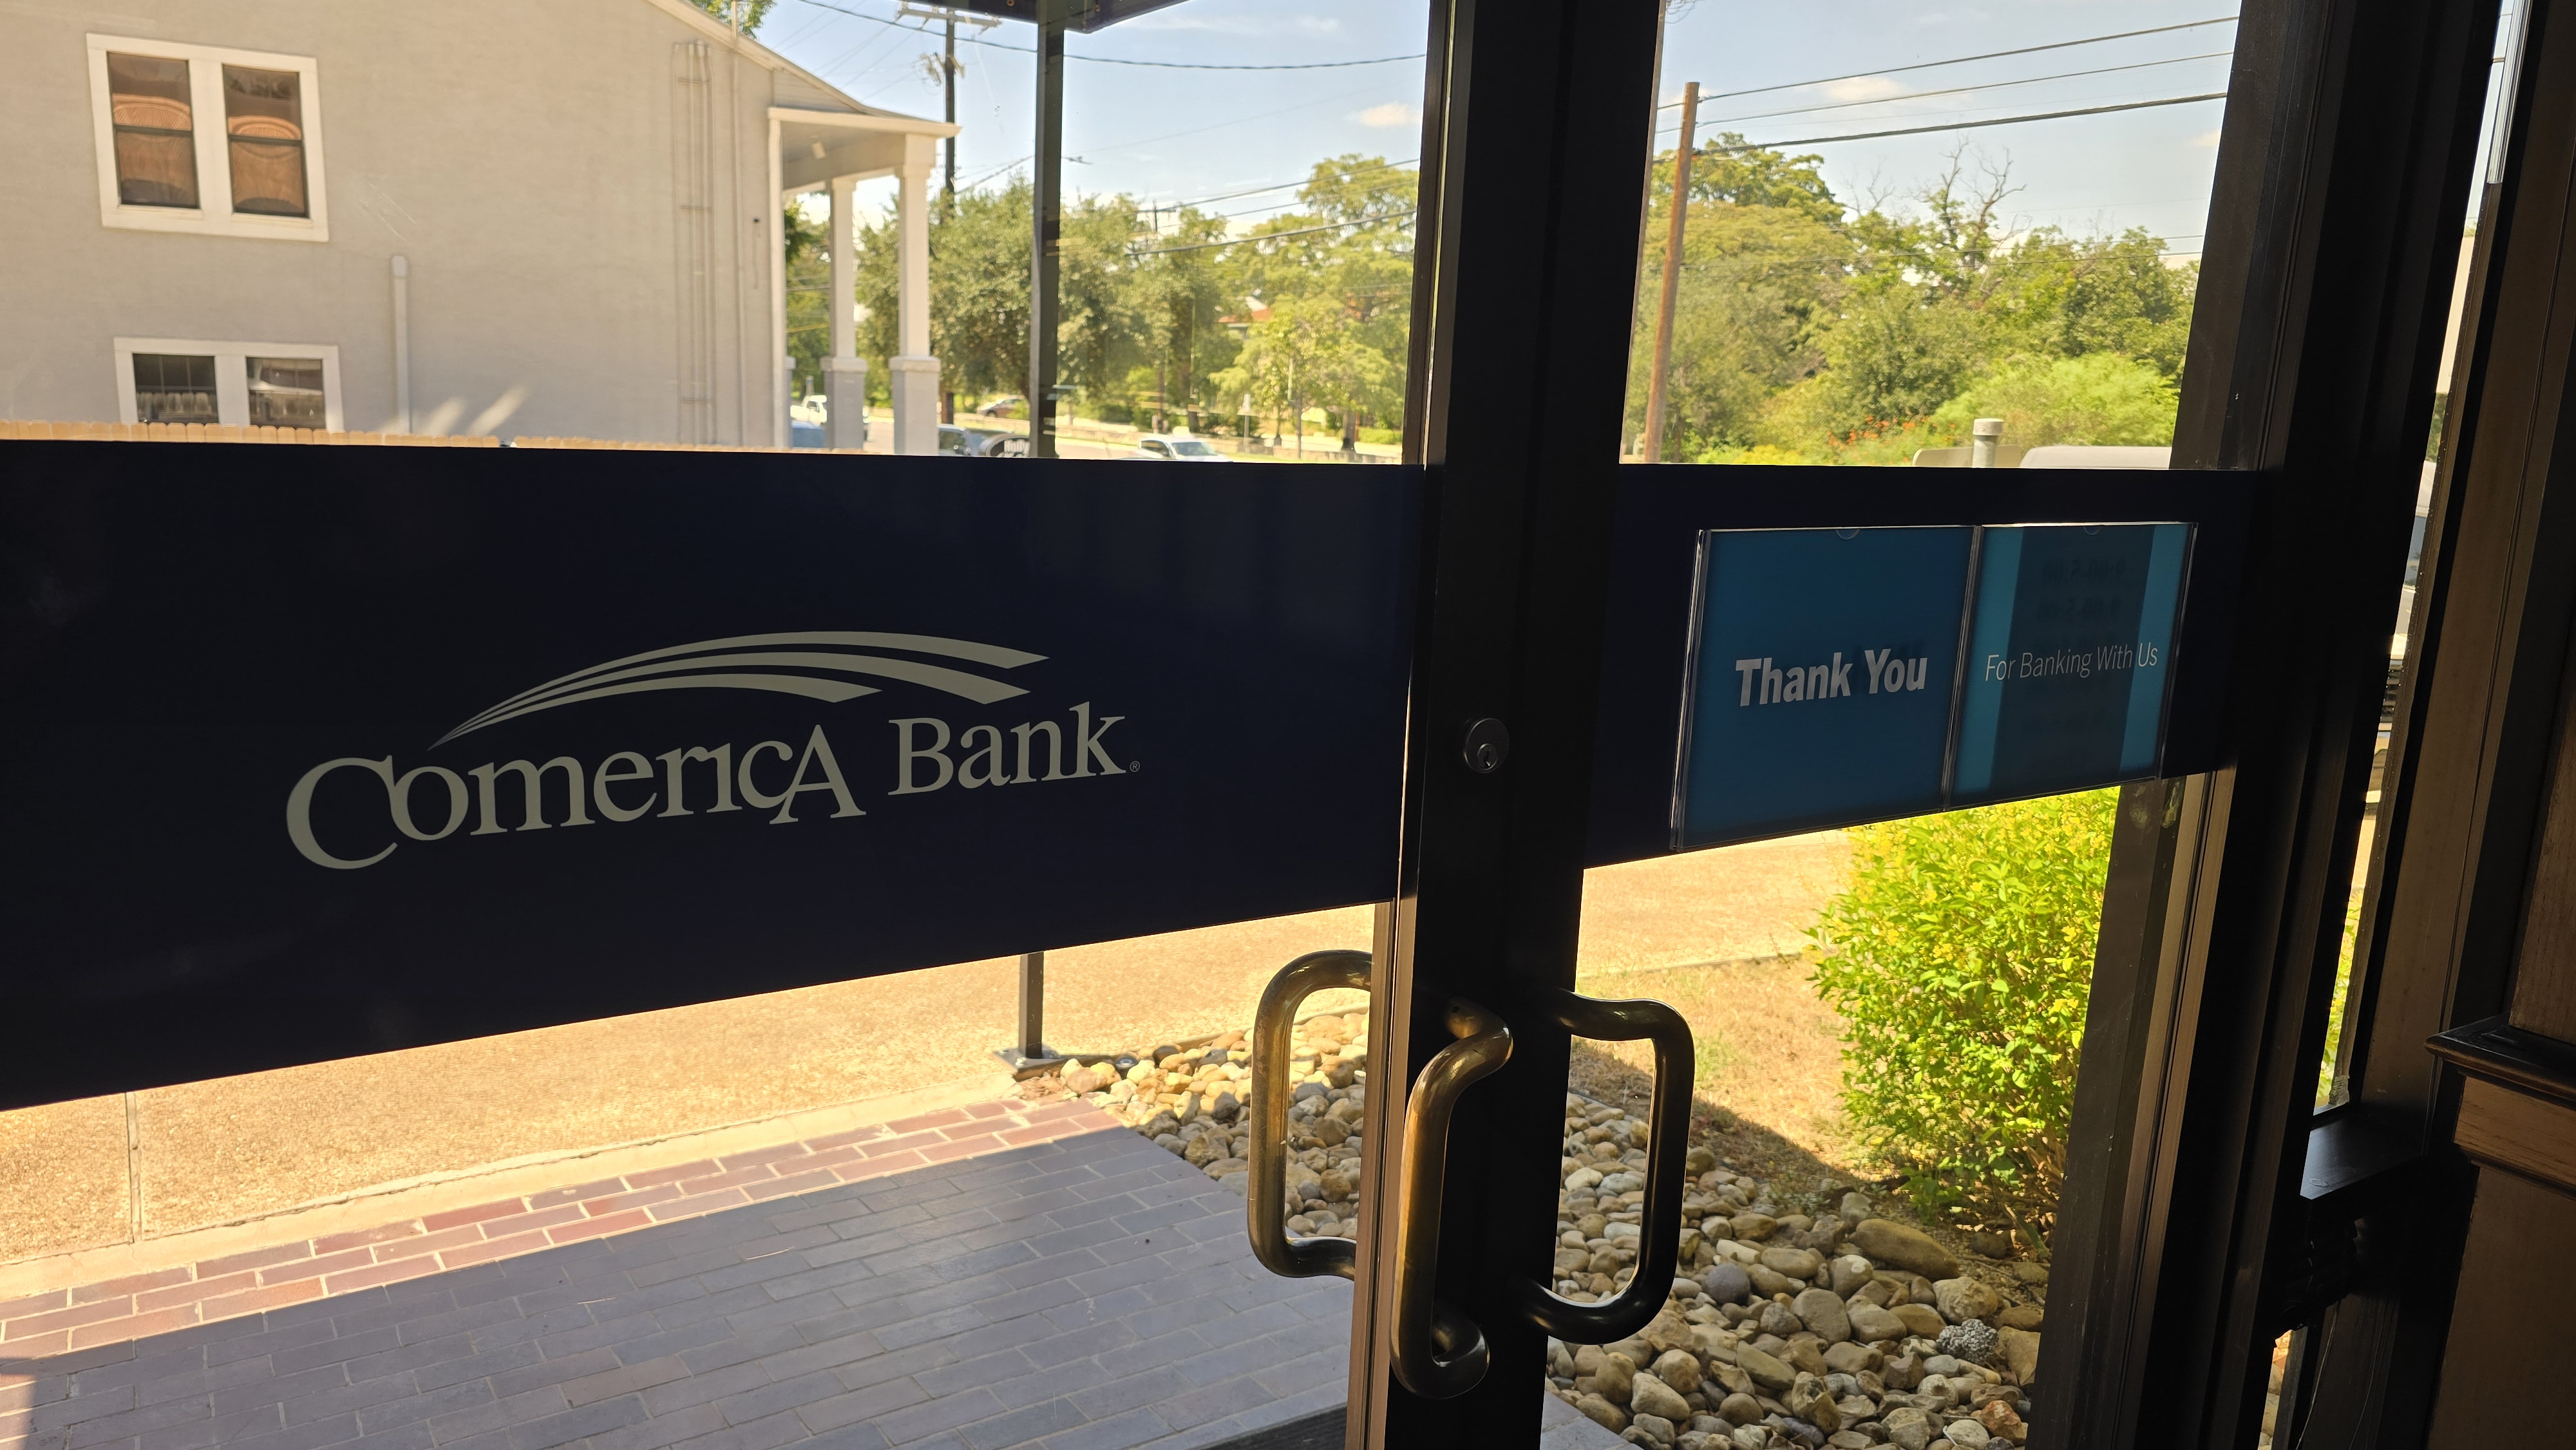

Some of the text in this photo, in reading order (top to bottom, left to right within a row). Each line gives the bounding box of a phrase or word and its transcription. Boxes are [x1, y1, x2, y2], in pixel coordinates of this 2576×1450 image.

[1735, 648, 1927, 707] Thank You
[1985, 654, 2016, 682] For
[2020, 648, 2092, 679] Banking
[2097, 643, 2134, 672] With
[2138, 642, 2159, 668] Us
